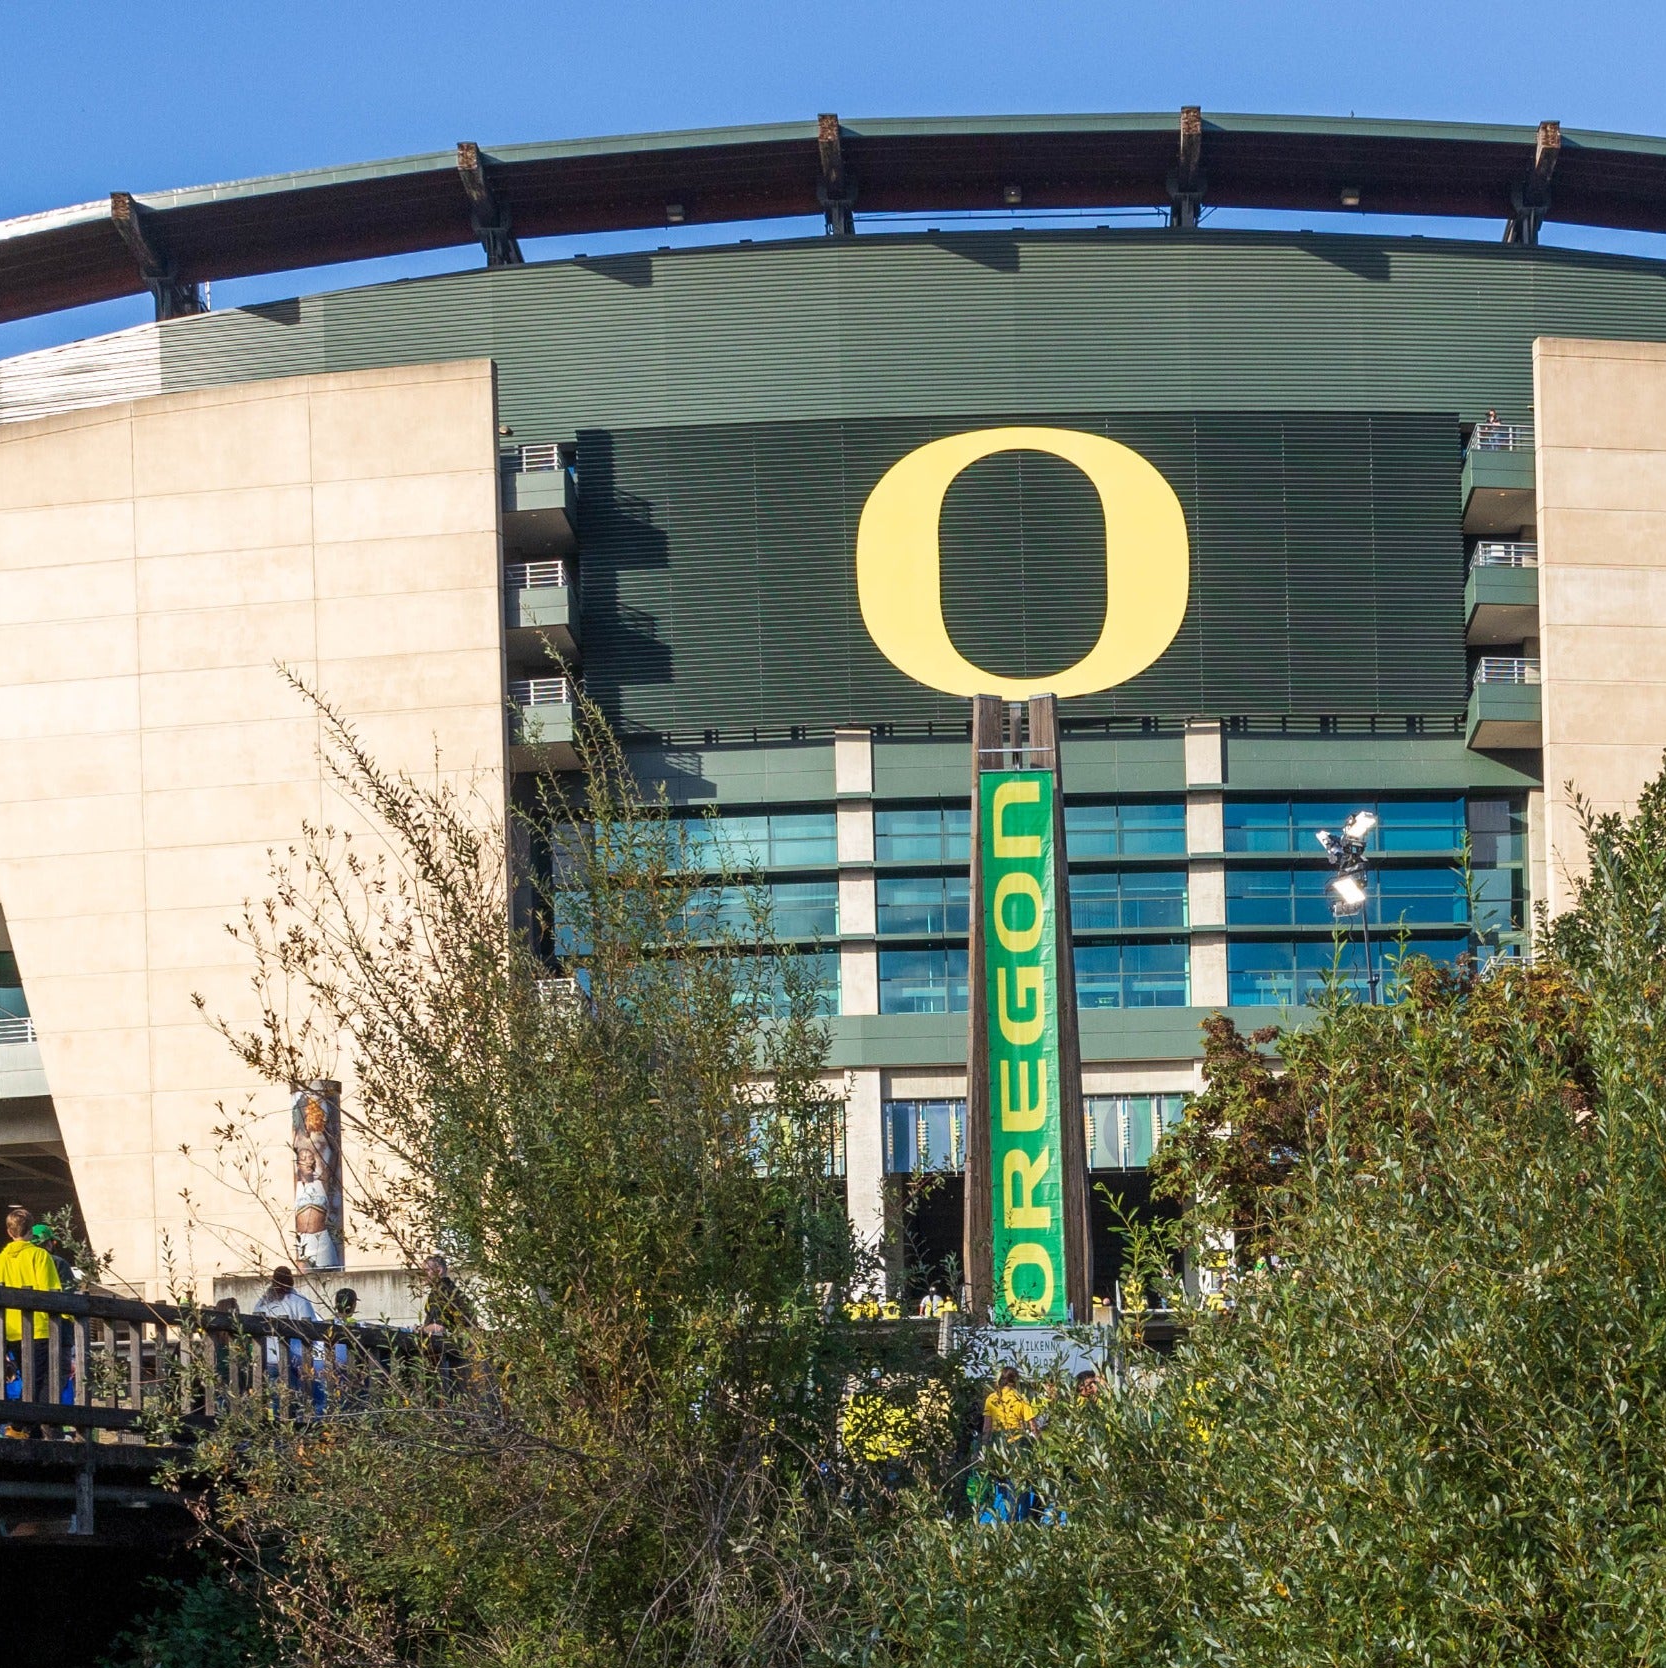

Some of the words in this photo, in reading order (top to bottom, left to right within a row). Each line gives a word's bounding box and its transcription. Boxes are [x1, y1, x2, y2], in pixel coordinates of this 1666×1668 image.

[856, 426, 1190, 701] O
[992, 781, 1055, 1324] OREGON
[1033, 1355, 1055, 1369] PLAZ
